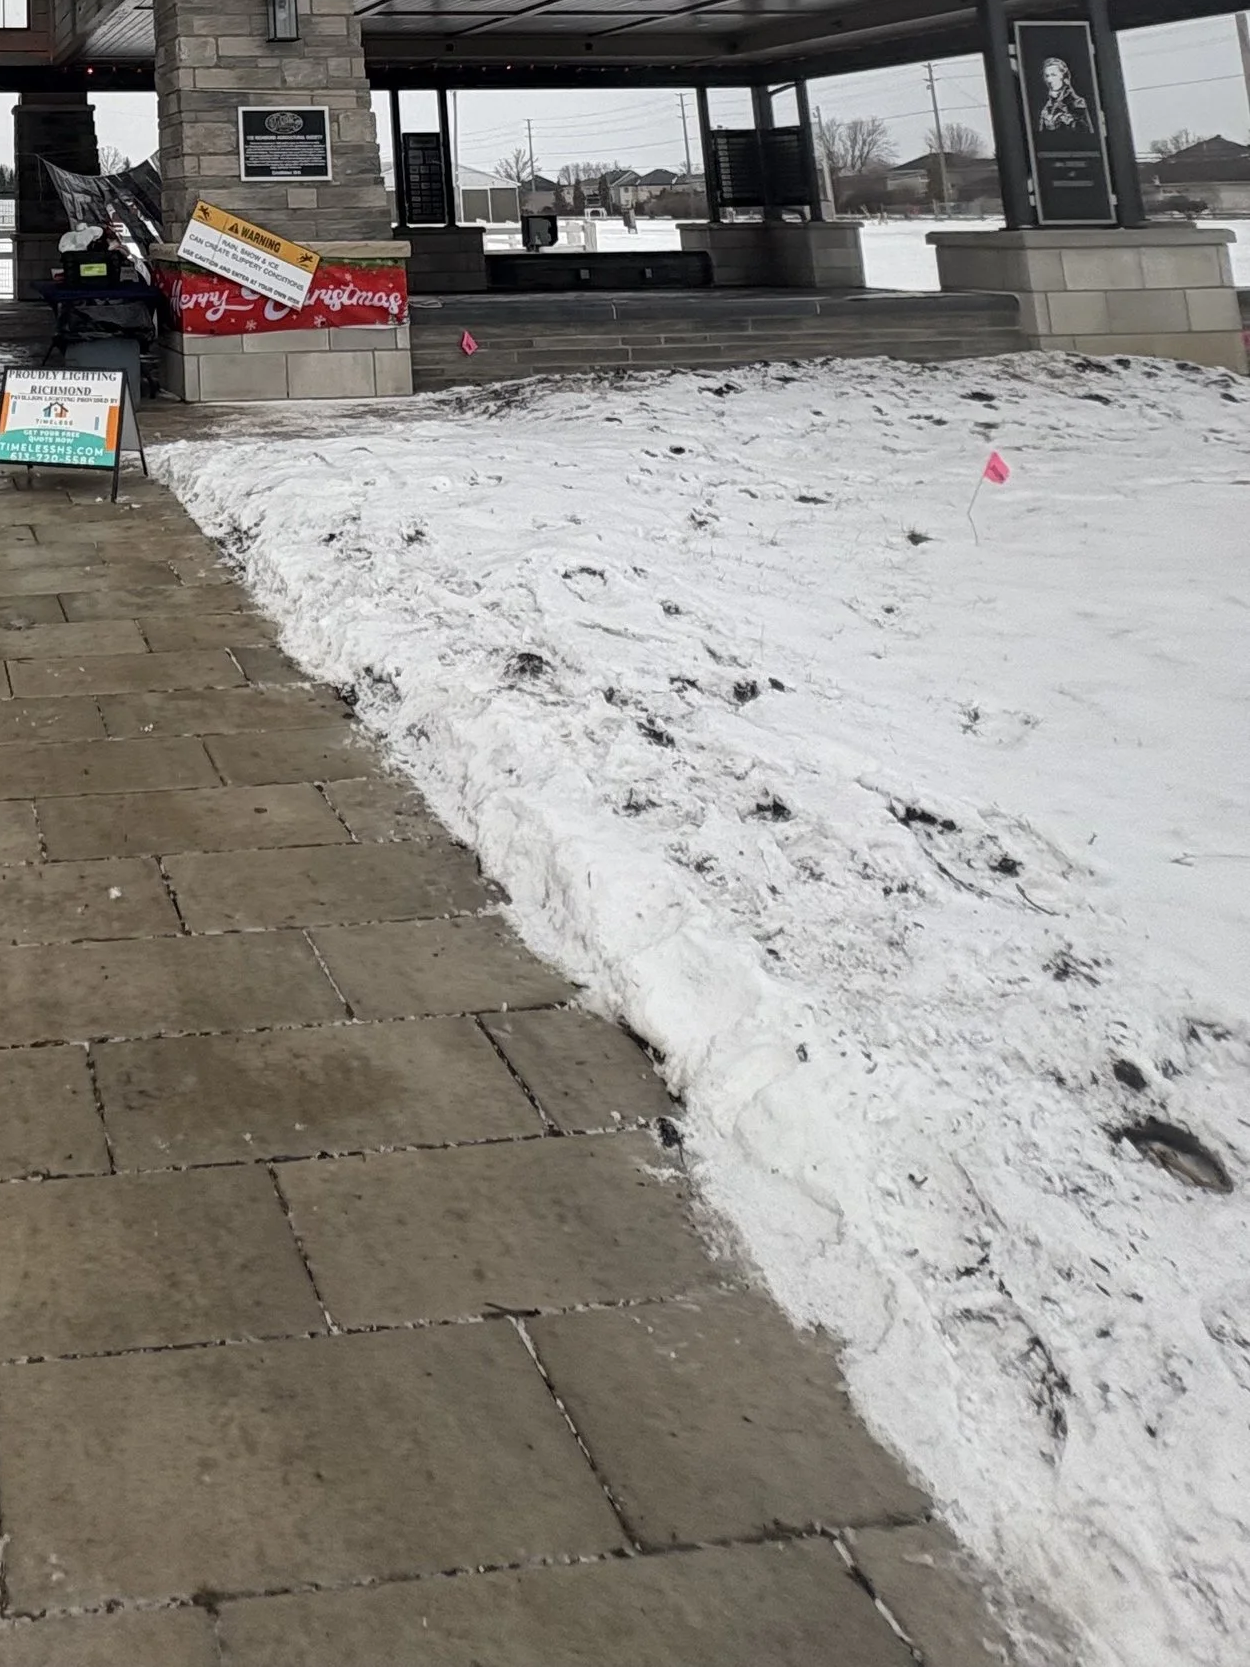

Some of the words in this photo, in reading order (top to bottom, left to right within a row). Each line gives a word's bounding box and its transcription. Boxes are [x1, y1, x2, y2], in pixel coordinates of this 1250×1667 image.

[241, 225, 281, 253] WARNING
[182, 247, 194, 257] USE
[194, 253, 219, 268] CAUTION
[189, 234, 204, 245] CAN
[204, 240, 229, 257] CREATE
[231, 253, 263, 272] SLIPPERY
[240, 246, 262, 262] SNOW
[268, 260, 280, 271] ICE
[171, 279, 254, 322] Merry
[9, 370, 61, 380] PROUDLY
[62, 372, 117, 381] LIGHTING
[30, 385, 92, 396] RICHMOND
[36, 418, 74, 426] TIMELESS
[0, 442, 103, 457] TIMELESSHS.COM
